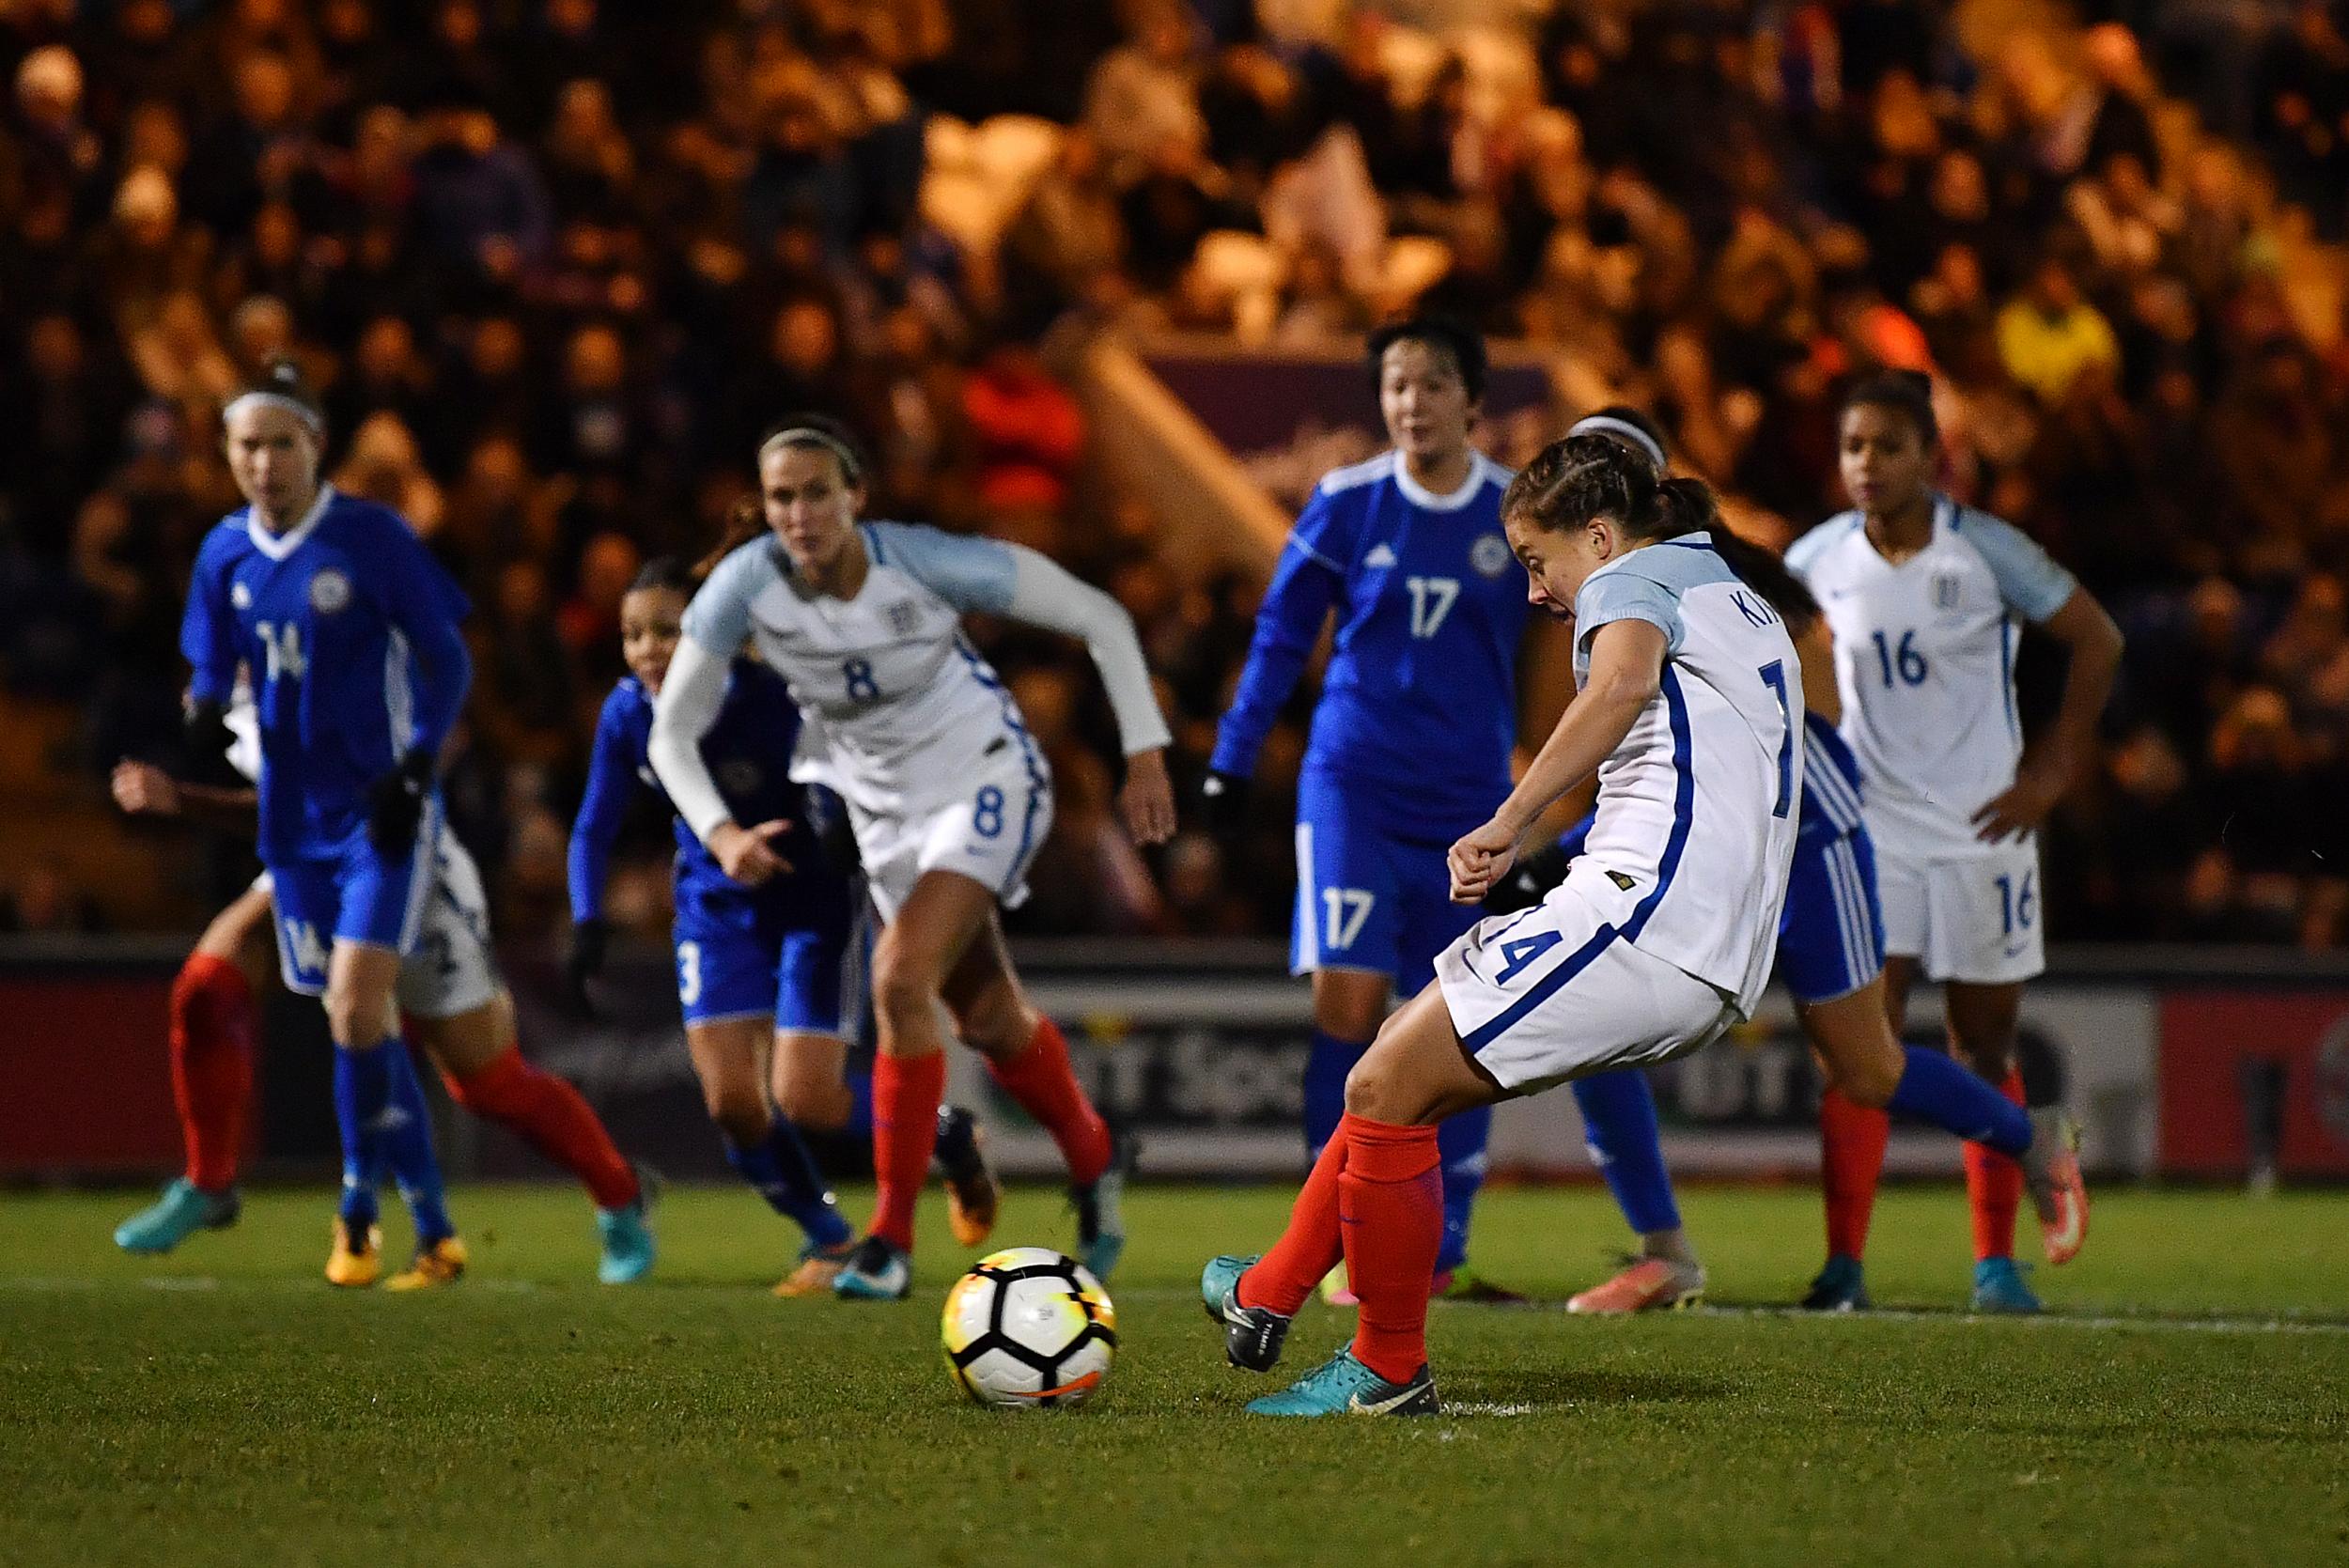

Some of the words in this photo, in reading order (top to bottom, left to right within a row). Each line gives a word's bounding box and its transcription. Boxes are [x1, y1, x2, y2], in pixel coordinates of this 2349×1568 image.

[1407, 576, 1460, 637] 17
[256, 619, 308, 682] 14
[1872, 629, 1928, 689] 16
[842, 657, 879, 706] 8
[974, 784, 1004, 839] 8
[1323, 887, 1375, 950] 17
